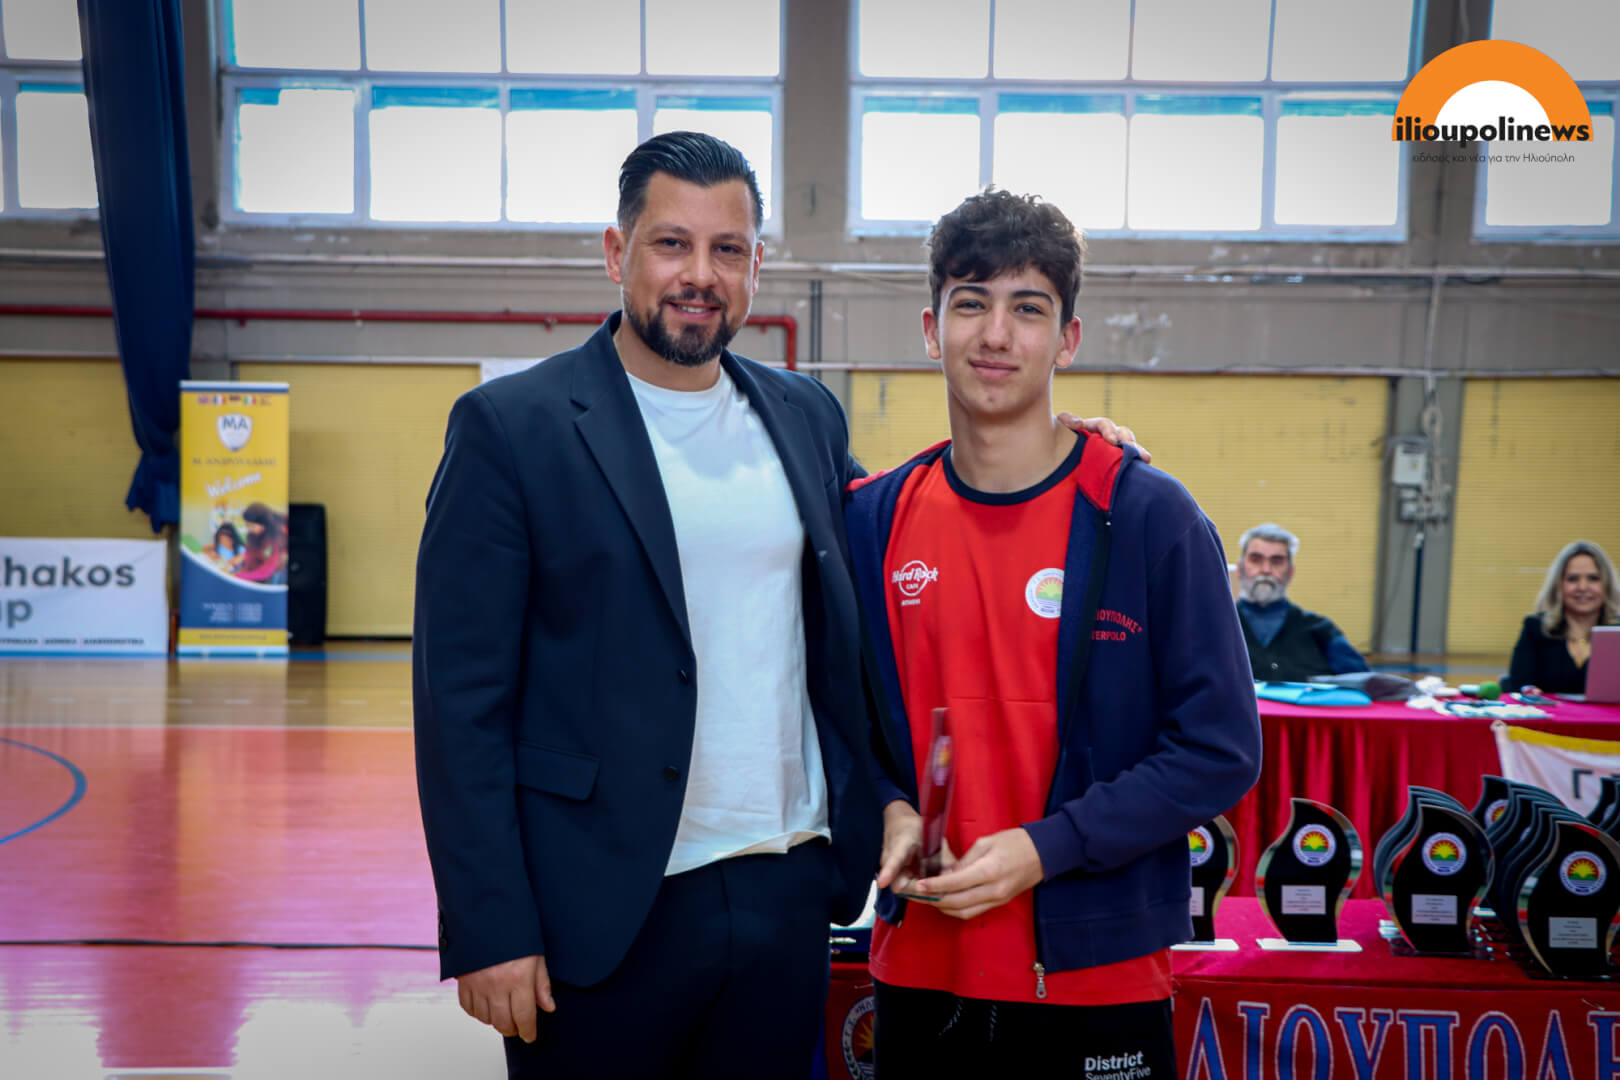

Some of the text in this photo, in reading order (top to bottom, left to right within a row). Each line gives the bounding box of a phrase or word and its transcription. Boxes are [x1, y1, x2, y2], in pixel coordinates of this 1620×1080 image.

[0, 556, 136, 587] hakos
[913, 567, 939, 583] Rock
[1084, 1050, 1144, 1071] District
